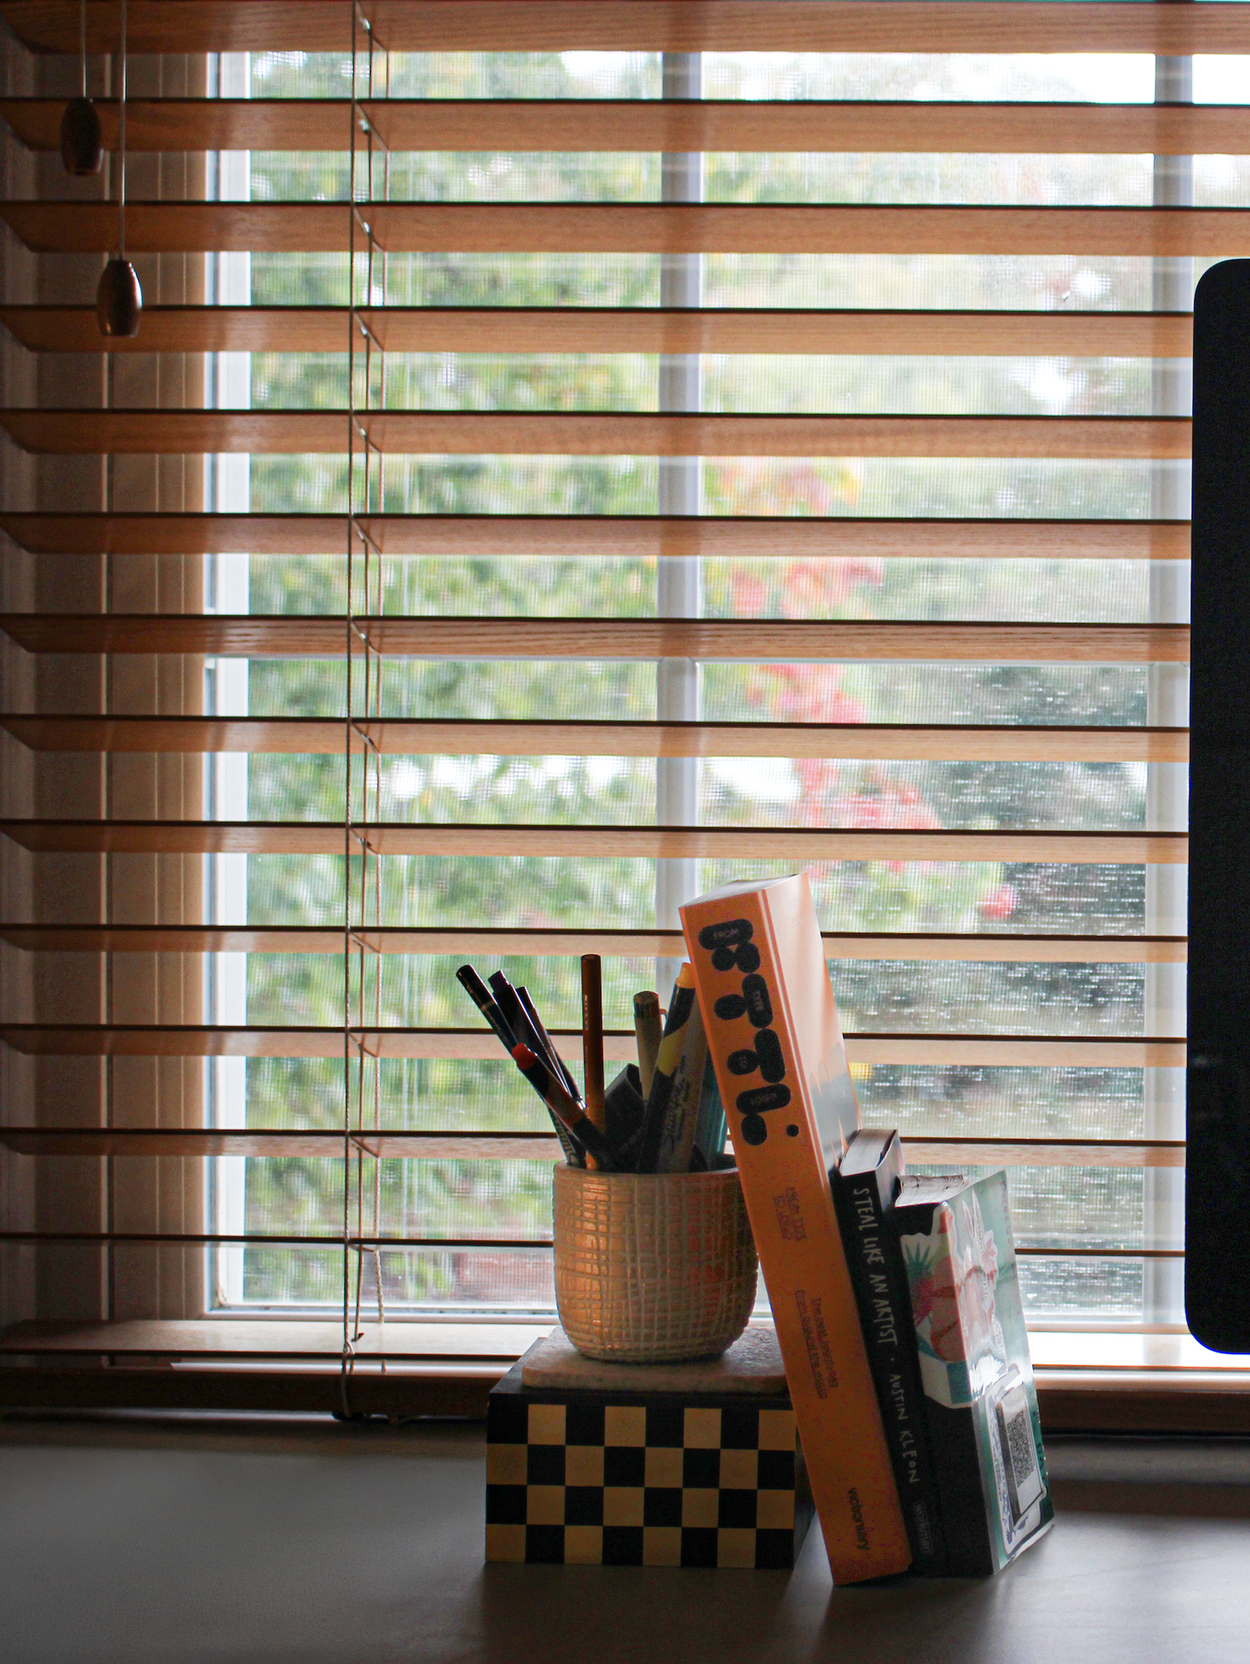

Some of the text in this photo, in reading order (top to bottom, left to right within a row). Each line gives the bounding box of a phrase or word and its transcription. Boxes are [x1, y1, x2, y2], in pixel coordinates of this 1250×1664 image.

[853, 1187, 898, 1346] STEAL LIKE AN ARTIST
[889, 1374, 920, 1483] AUSTIN KLEON
[915, 1504, 931, 1554] workman
